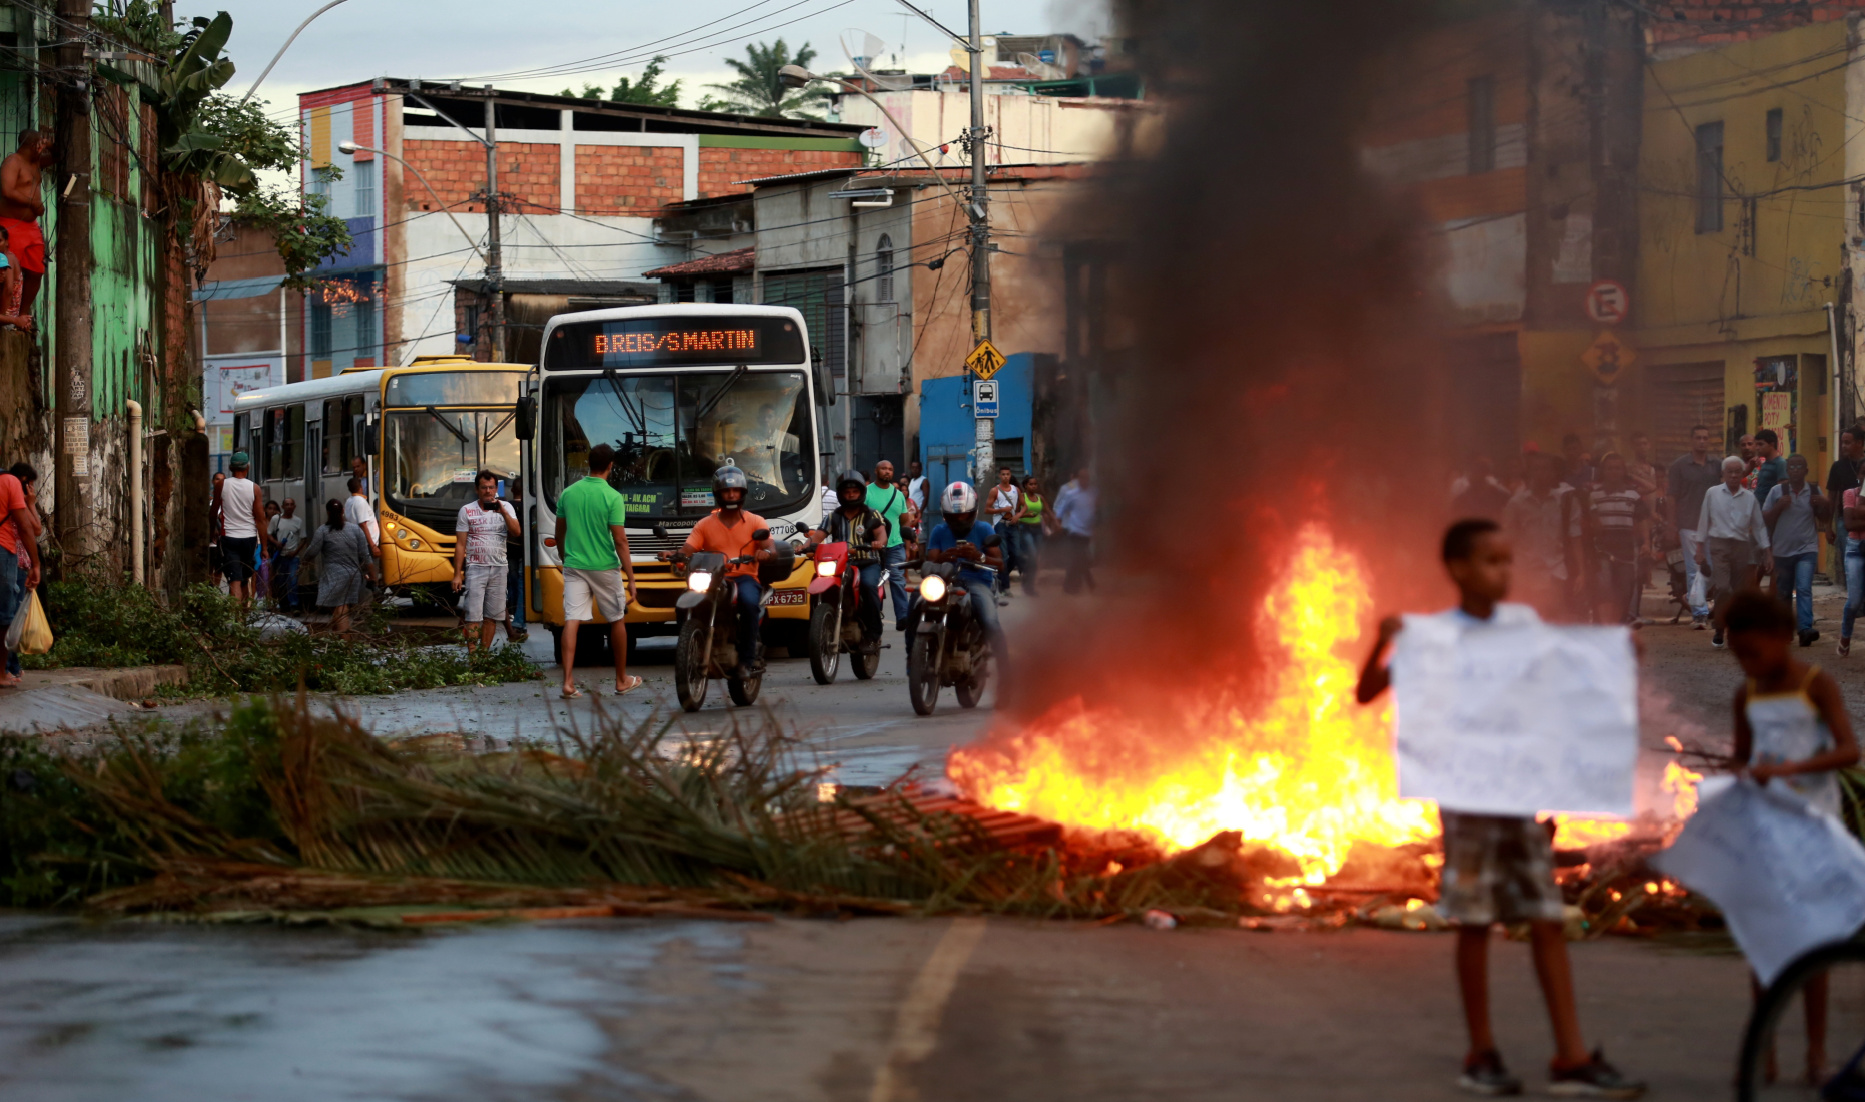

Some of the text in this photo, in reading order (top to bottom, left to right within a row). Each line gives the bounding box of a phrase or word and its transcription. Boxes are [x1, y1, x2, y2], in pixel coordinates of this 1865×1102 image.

[595, 330, 755, 353] B.REIS/S.MARTIN
[1763, 393, 1788, 411] CIMENTO
[1764, 411, 1780, 426] POTY
[642, 494, 657, 503] ACM
[380, 510, 399, 521] 4983
[658, 520, 699, 528] Marcopolo
[770, 525, 795, 535] 37708
